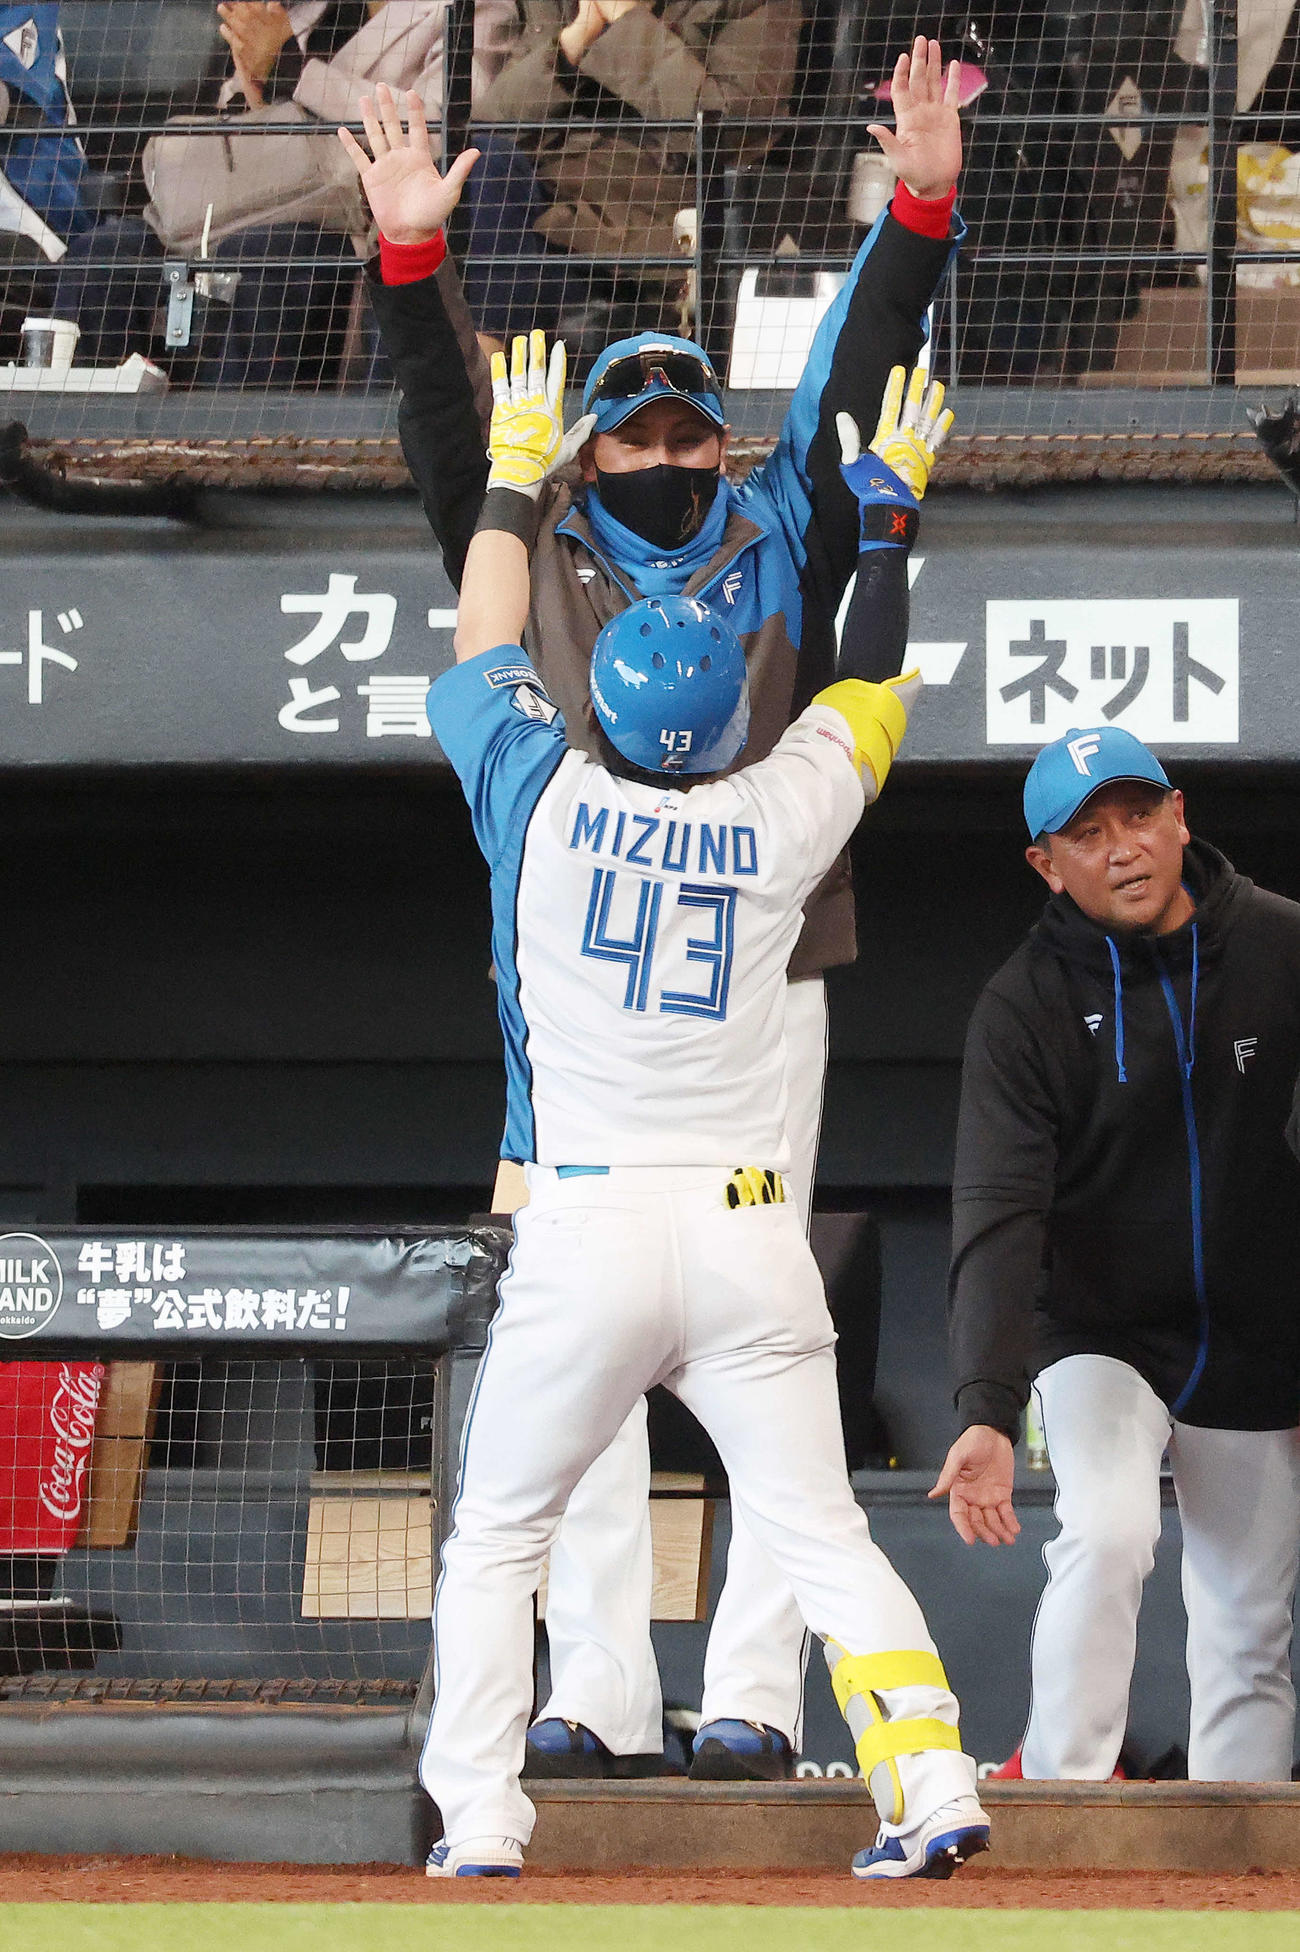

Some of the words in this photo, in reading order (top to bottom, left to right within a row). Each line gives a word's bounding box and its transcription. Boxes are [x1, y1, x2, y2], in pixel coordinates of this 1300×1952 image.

[0, 608, 84, 704] ド
[999, 619, 1227, 724] ネット
[278, 676, 432, 737] と言
[659, 728, 693, 752] 43
[1066, 733, 1101, 777] F
[569, 802, 758, 876] MIZUNO
[580, 867, 739, 1022] 43
[1233, 1037, 1258, 1074] F
[0, 1259, 51, 1283] ILK
[78, 1241, 187, 1284] 牛乳は
[0, 1287, 53, 1312] AND
[0, 1315, 36, 1325] okkaido
